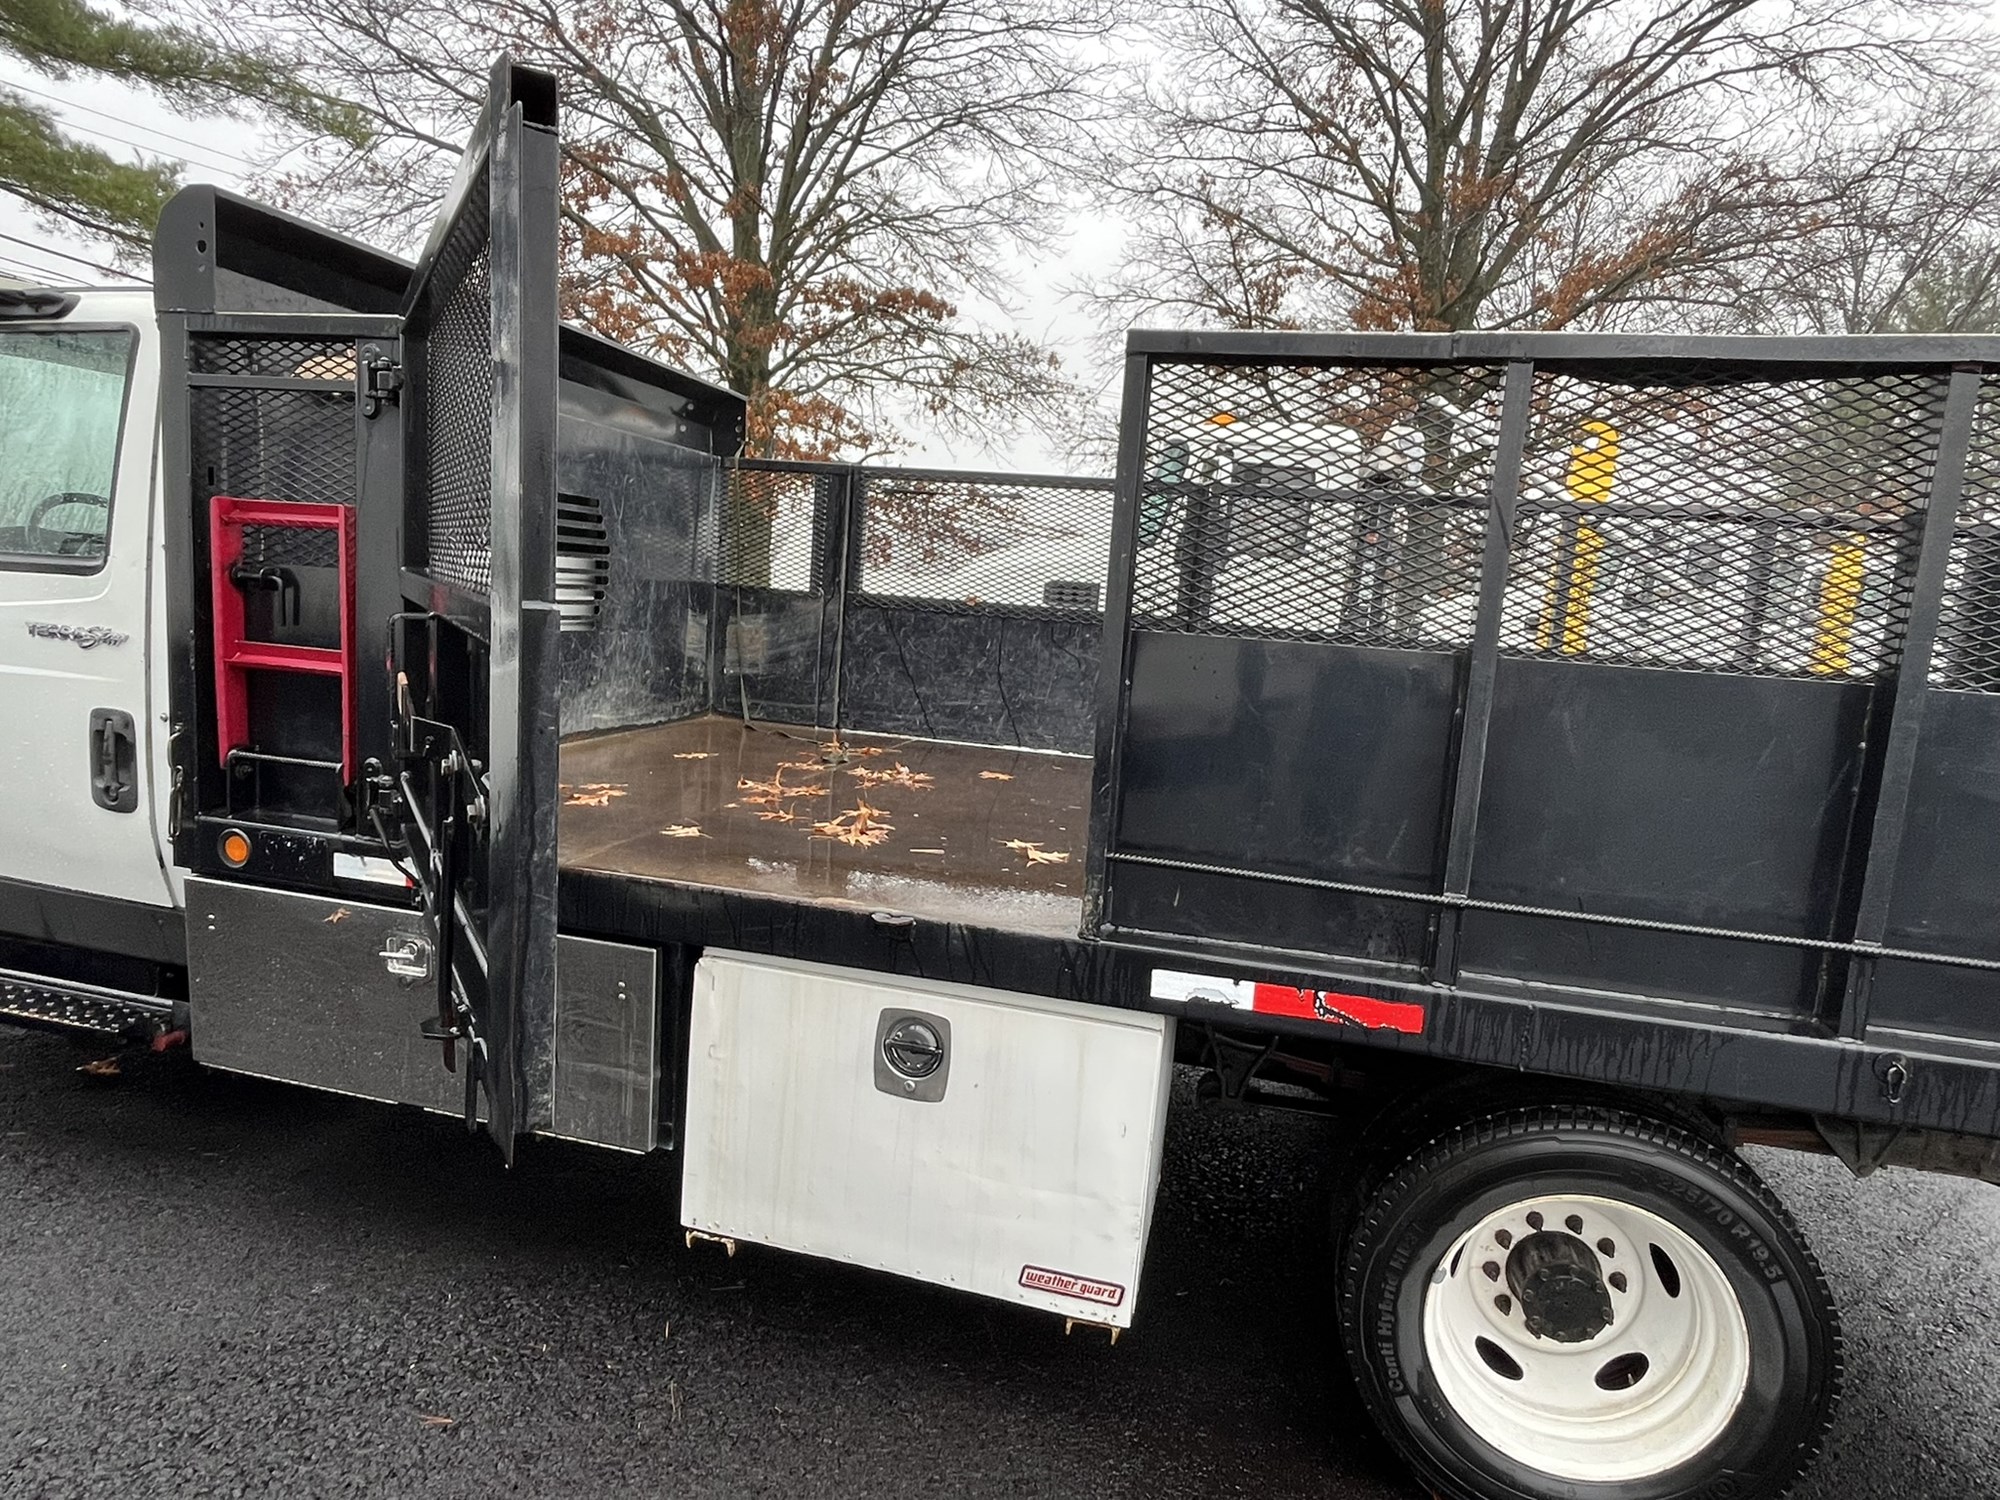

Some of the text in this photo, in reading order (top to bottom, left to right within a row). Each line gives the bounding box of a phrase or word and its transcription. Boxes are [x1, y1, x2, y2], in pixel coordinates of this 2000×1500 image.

[1730, 1222, 1751, 1239] R
[1747, 1238, 1784, 1279] 19.5
[1025, 1270, 1117, 1299] weather guard
[1376, 1270, 1400, 1337] Hybrid
[1377, 1341, 1405, 1392] Conti
